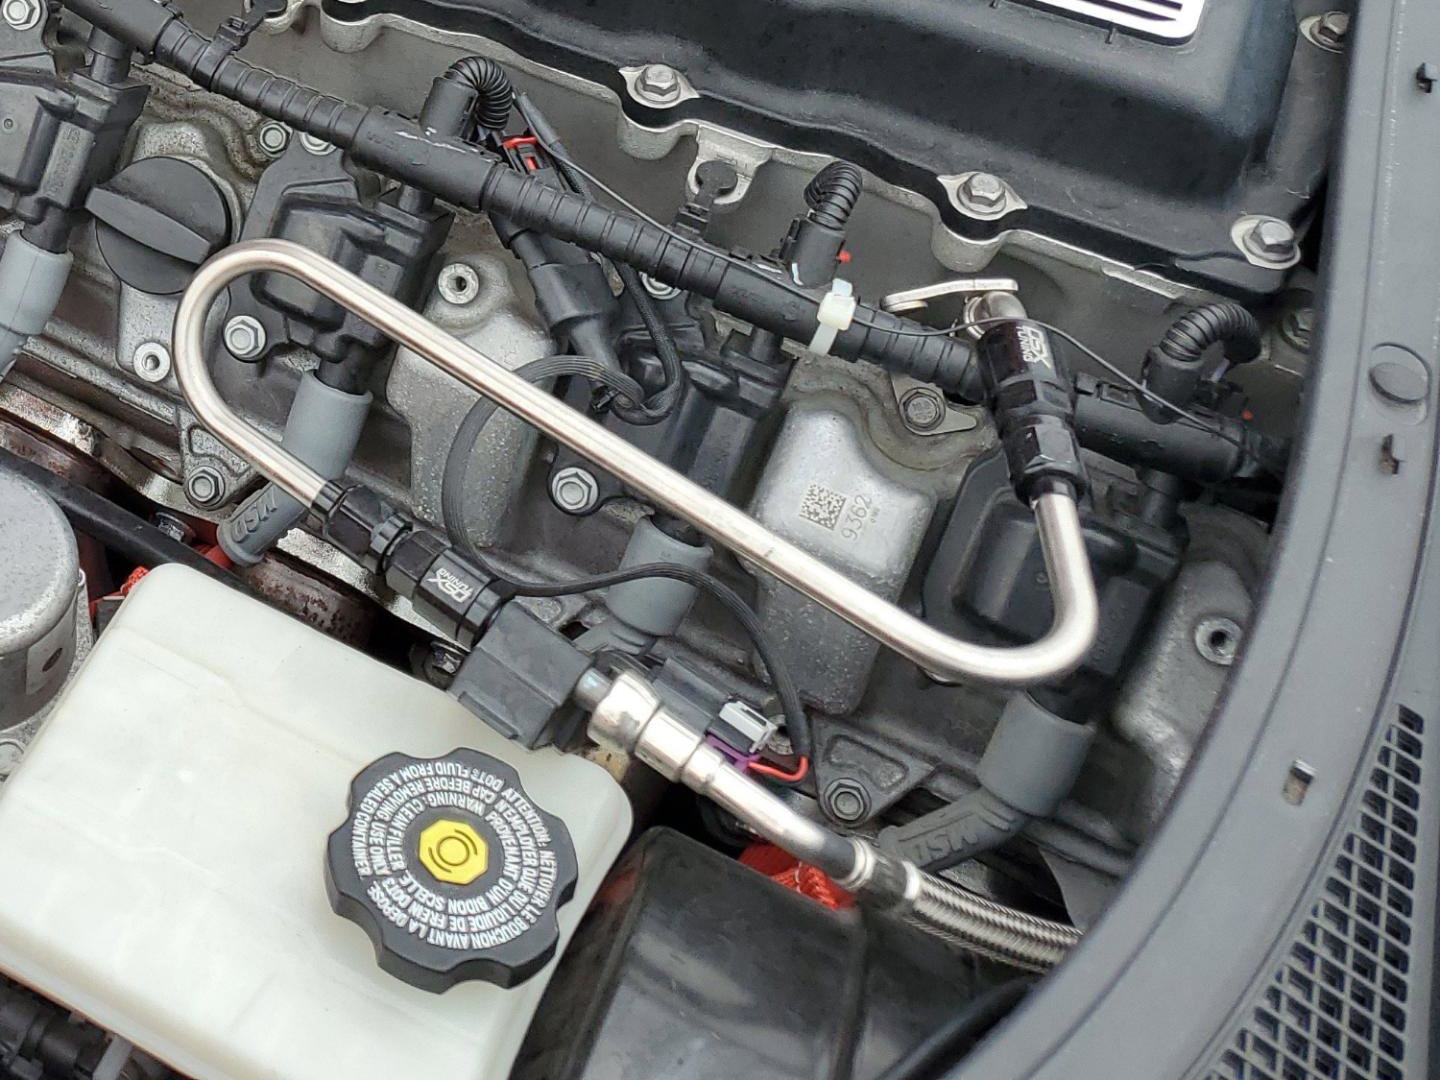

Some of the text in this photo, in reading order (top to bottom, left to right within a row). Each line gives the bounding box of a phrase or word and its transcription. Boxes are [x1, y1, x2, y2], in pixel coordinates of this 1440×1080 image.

[1016, 326, 1033, 362] TUNING
[233, 491, 279, 543] MSD
[841, 494, 872, 541] 9362
[437, 567, 475, 594] TUNING
[389, 775, 402, 785] A
[399, 762, 434, 782] FROM
[435, 762, 471, 778] FLUID
[360, 778, 397, 816] SEALED
[424, 776, 472, 794] BEFORE
[472, 785, 497, 804] CAP
[391, 798, 425, 831] CLEAN
[369, 821, 388, 846] USE
[485, 810, 522, 881] PROVENANT
[369, 846, 392, 875] ONLY
[386, 827, 407, 871] FILLER
[517, 866, 538, 895] QUE
[530, 850, 558, 908] NETTOYER
[448, 896, 491, 915] BIDON
[508, 890, 529, 912] DU
[520, 904, 543, 924] LE
[408, 901, 448, 930] FREIN
[408, 918, 429, 939] LA
[449, 916, 468, 932] DE
[468, 902, 517, 932] LIQUIDE
[427, 928, 470, 950] AVANT
[470, 916, 530, 949] BOUCHON
